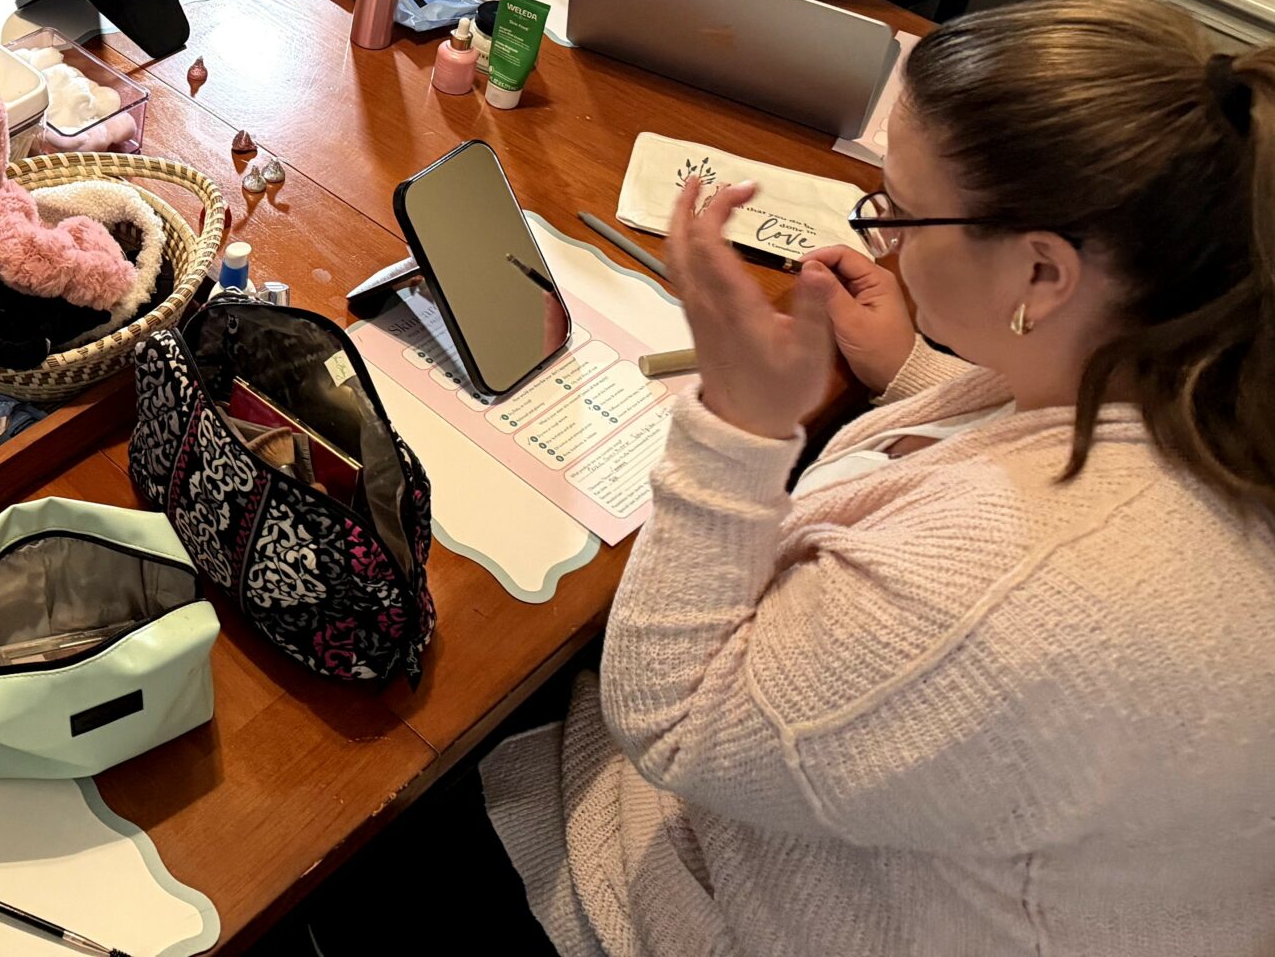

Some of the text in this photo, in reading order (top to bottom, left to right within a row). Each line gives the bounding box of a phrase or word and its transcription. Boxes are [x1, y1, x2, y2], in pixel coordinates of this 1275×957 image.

[507, 2, 537, 21] WELEDA
[768, 211, 787, 221] you
[756, 217, 816, 248] love
[779, 223, 803, 233] done
